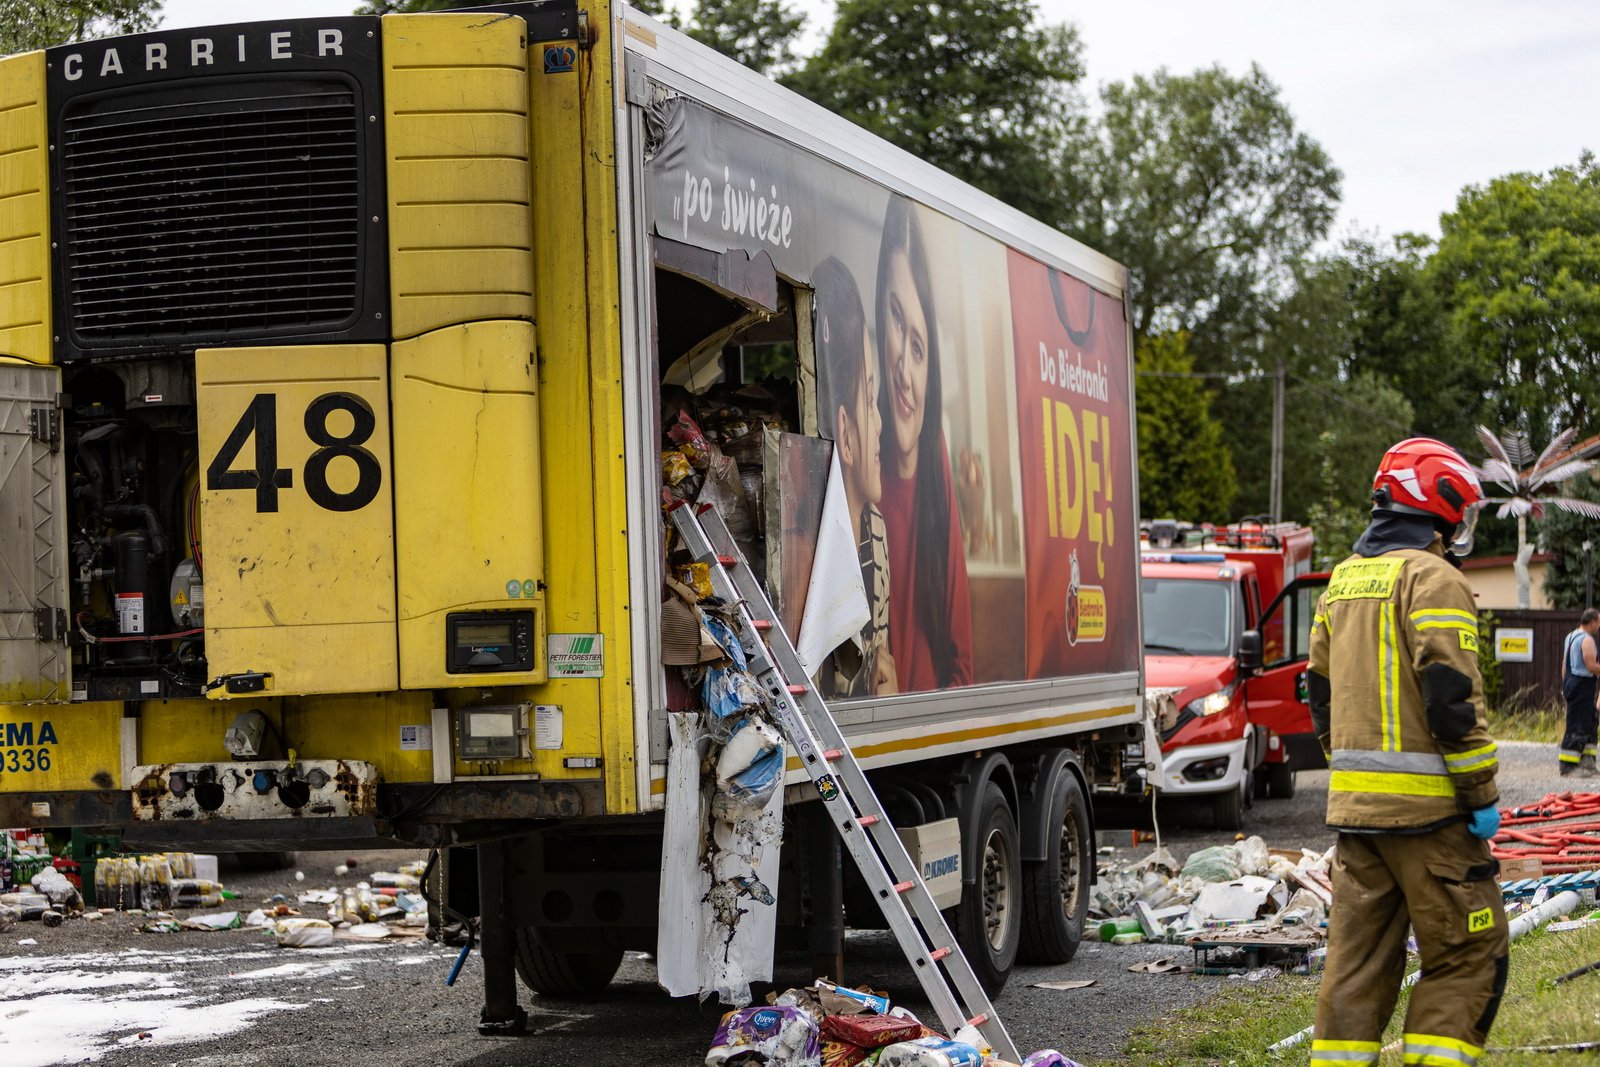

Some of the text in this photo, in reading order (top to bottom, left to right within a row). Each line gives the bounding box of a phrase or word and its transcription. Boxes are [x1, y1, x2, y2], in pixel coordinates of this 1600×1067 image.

[63, 28, 344, 82] CARRIER
[721, 165, 792, 249] świeże
[1039, 341, 1109, 404] Do Biedronki
[206, 390, 383, 513] 48
[1041, 396, 1115, 580] IDĘ!
[931, 854, 959, 879] KRONE
[1473, 912, 1490, 929] PSP
